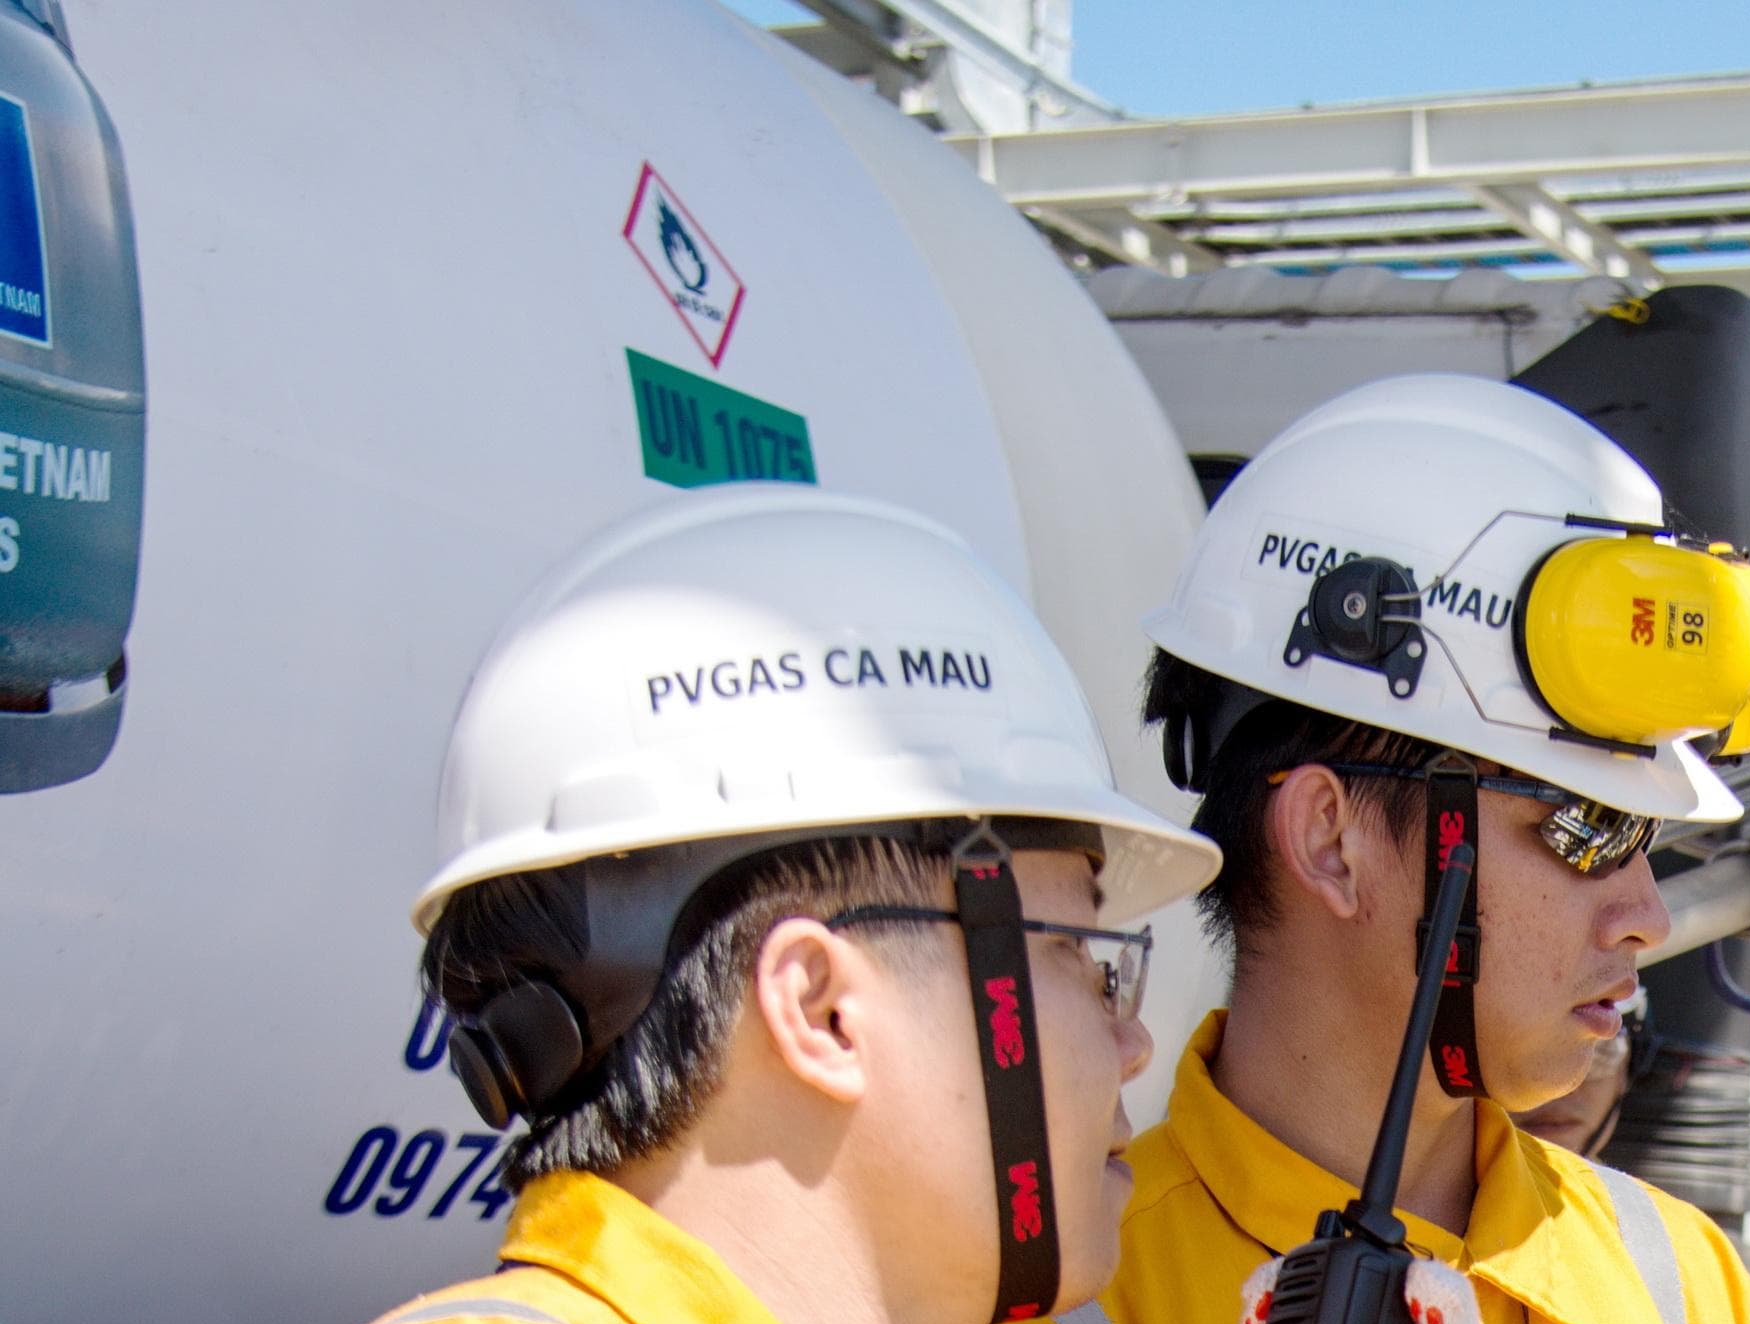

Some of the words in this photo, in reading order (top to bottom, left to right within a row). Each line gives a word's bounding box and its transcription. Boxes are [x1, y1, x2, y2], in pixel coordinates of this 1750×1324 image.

[641, 380, 706, 470] UN
[1258, 533, 1362, 578] PVGA
[1427, 575, 1512, 629] MAU
[1631, 597, 1655, 646] 3M
[1682, 612, 1704, 646] 98
[647, 652, 806, 714] PVGAS
[824, 649, 887, 687] CA
[898, 649, 992, 692] MAU
[985, 977, 1025, 1068] 3M
[1442, 1045, 1474, 1088] 3M
[1008, 1161, 1042, 1242] 3M
